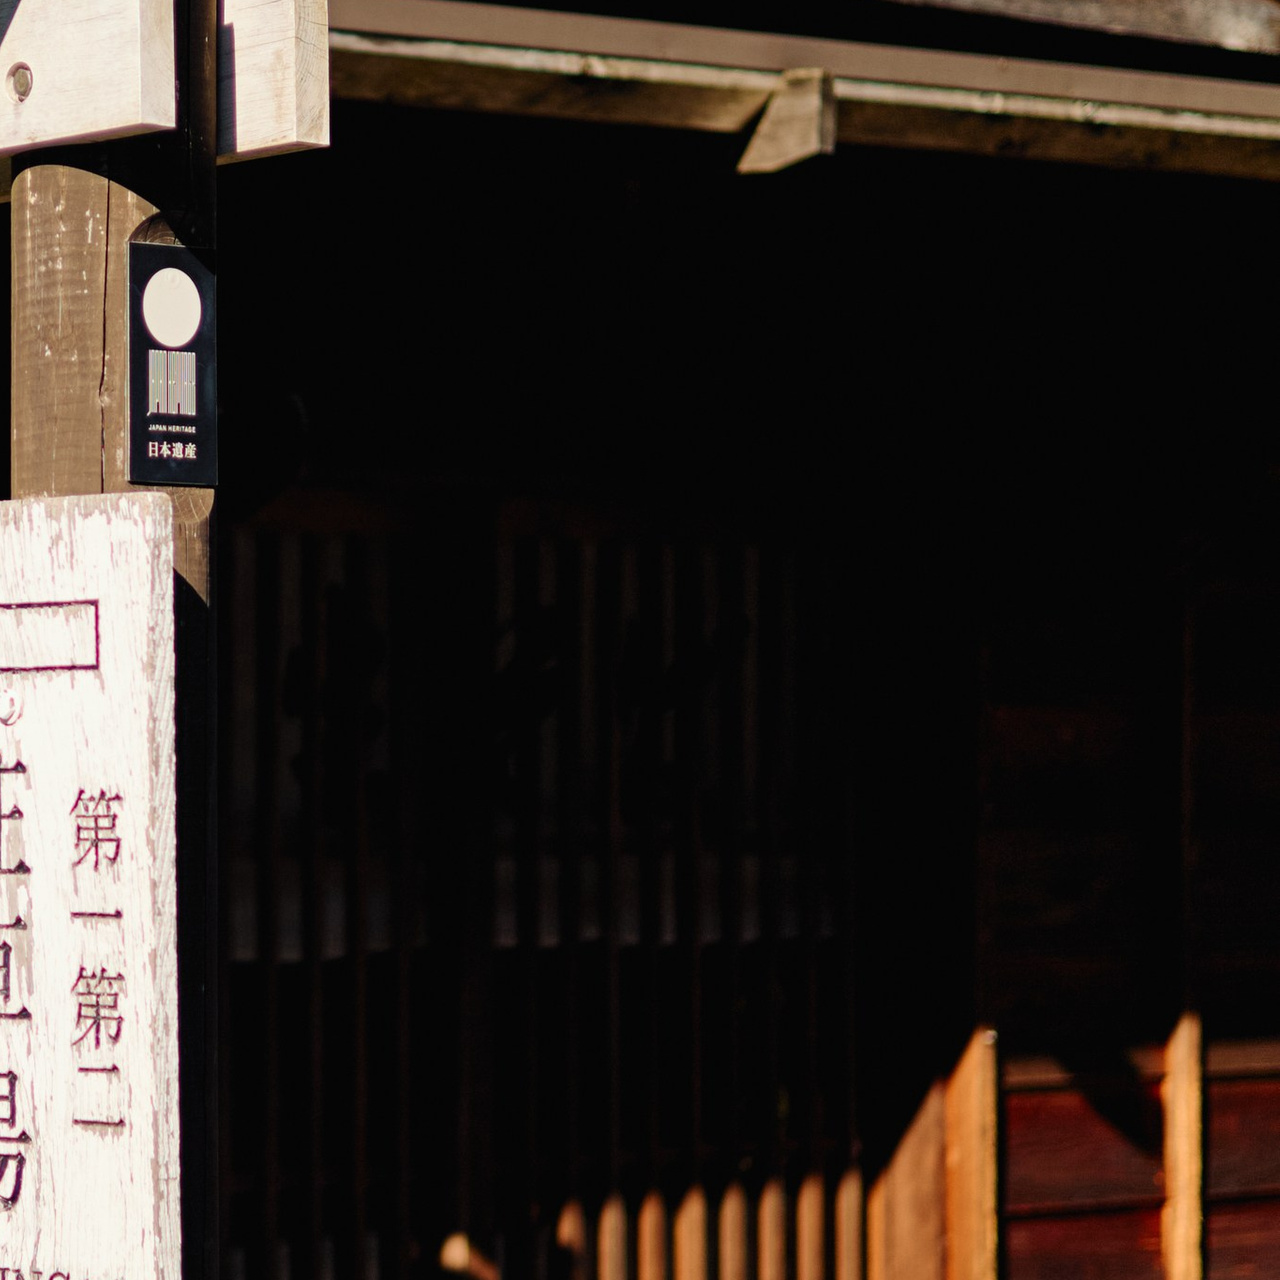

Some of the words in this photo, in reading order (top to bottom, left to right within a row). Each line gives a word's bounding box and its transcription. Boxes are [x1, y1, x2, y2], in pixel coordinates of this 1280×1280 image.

[148, 424, 167, 432] JAPAN
[167, 425, 196, 434] HERITAGE
[148, 441, 197, 459] 日本遺産
